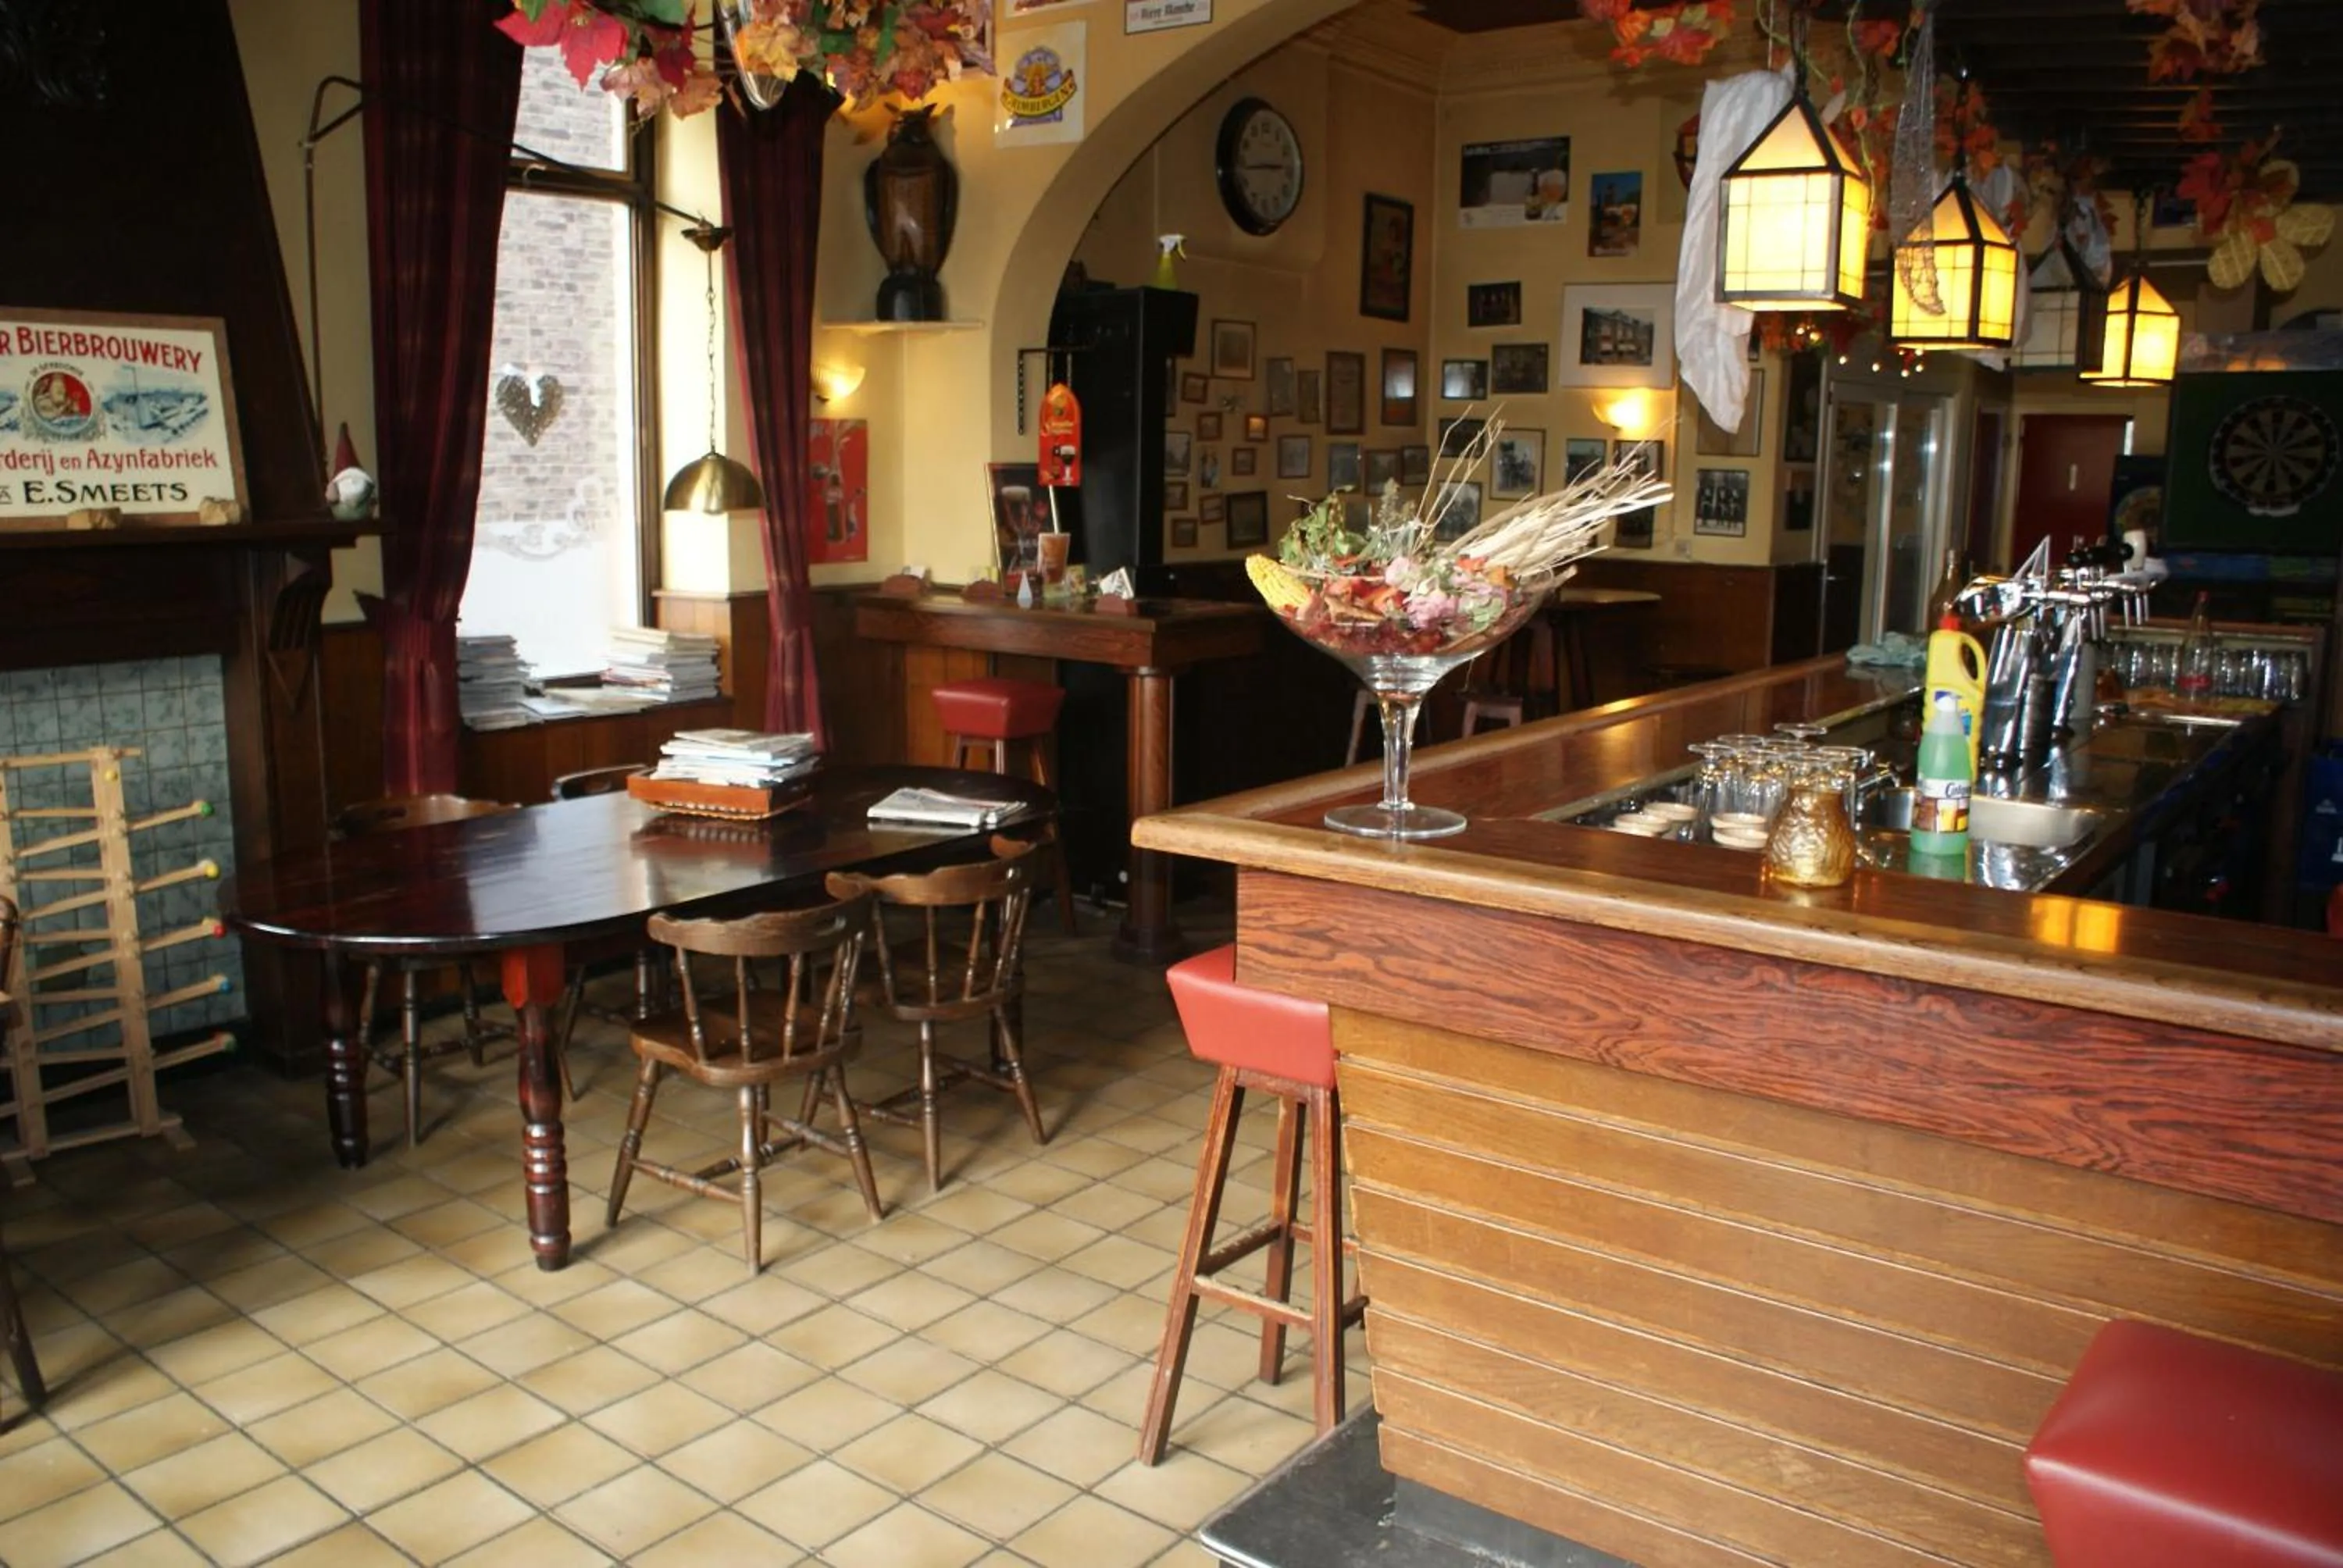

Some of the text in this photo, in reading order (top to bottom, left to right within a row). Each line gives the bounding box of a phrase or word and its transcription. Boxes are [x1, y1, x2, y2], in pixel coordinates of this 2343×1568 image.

[16, 326, 201, 373] BIERBROUWERY
[60, 454, 81, 468] en
[86, 448, 218, 474] Azynfabriek
